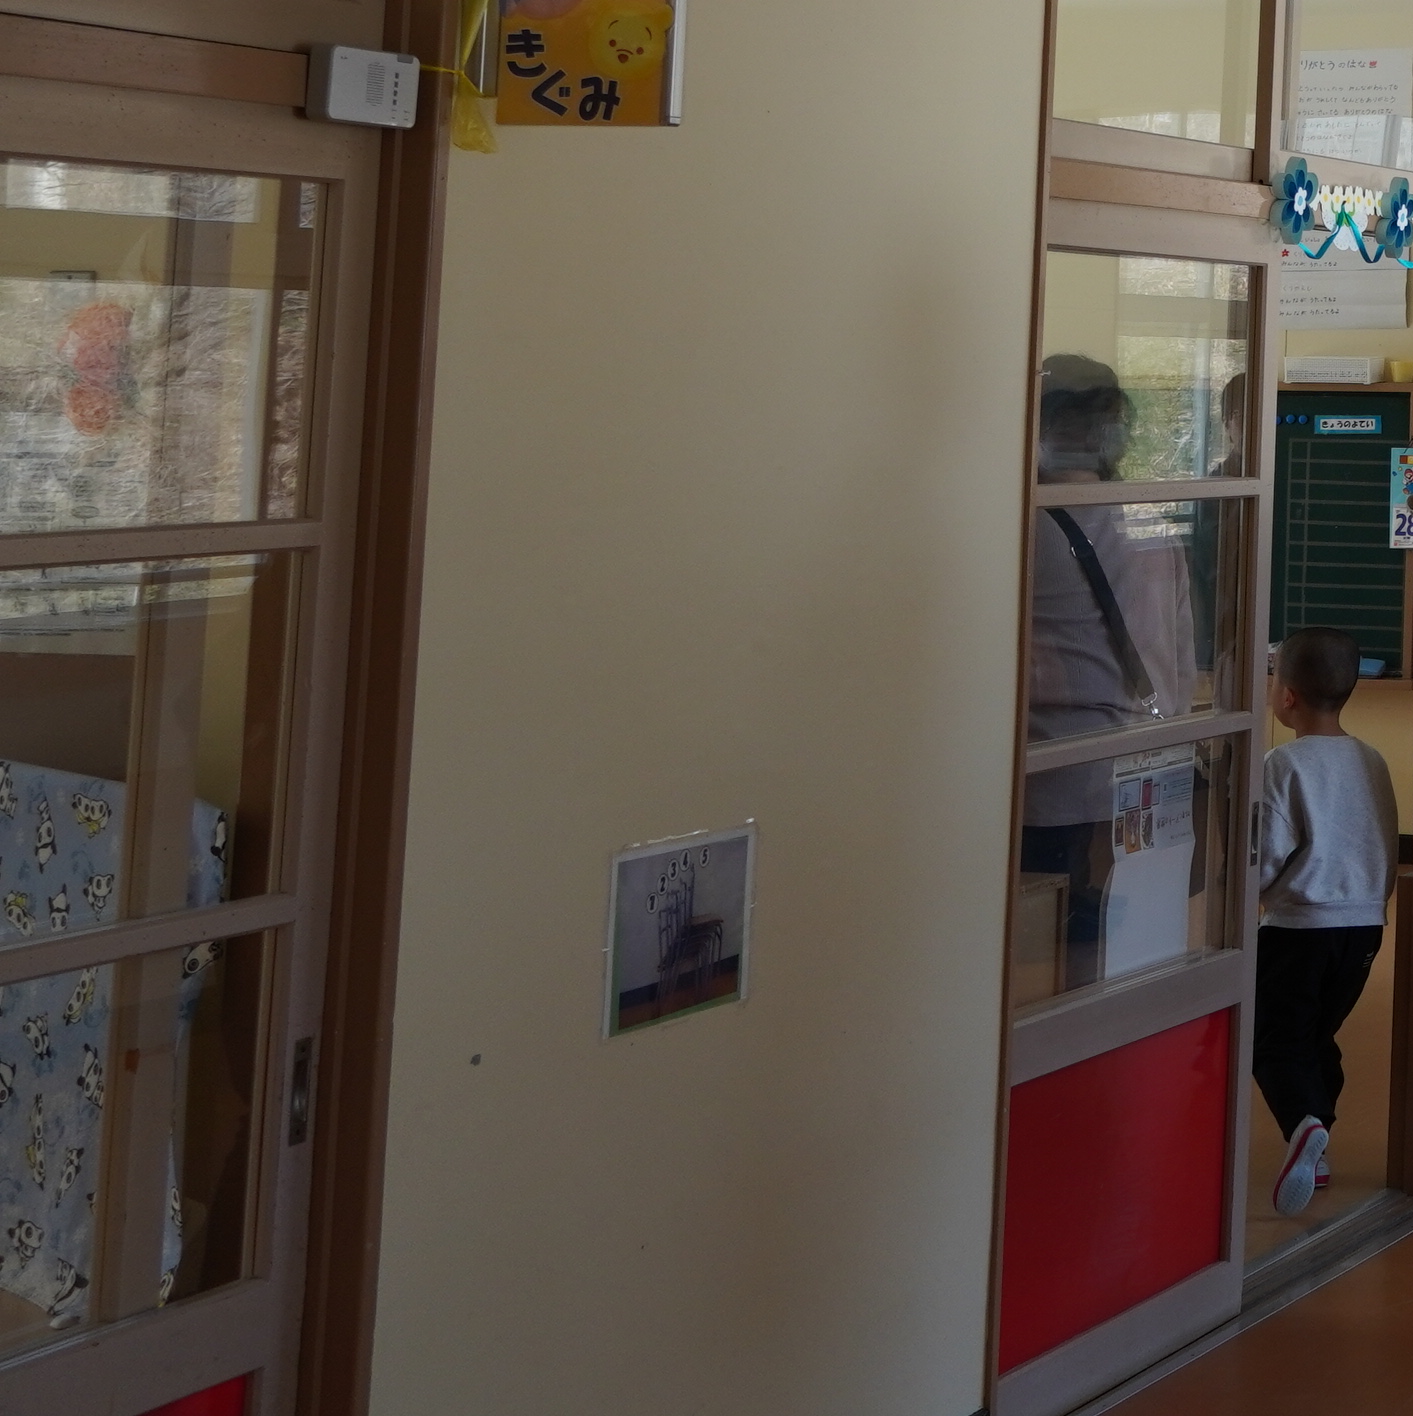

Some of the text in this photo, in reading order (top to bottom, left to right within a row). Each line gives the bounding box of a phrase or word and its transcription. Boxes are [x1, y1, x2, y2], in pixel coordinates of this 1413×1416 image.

[505, 28, 621, 121] きぐみ
[1321, 420, 1374, 429] きょうのよてい
[682, 852, 688, 868] 4
[702, 848, 708, 864] 5
[670, 862, 676, 878] 3
[660, 877, 666, 892] 2
[649, 895, 655, 910] 1
